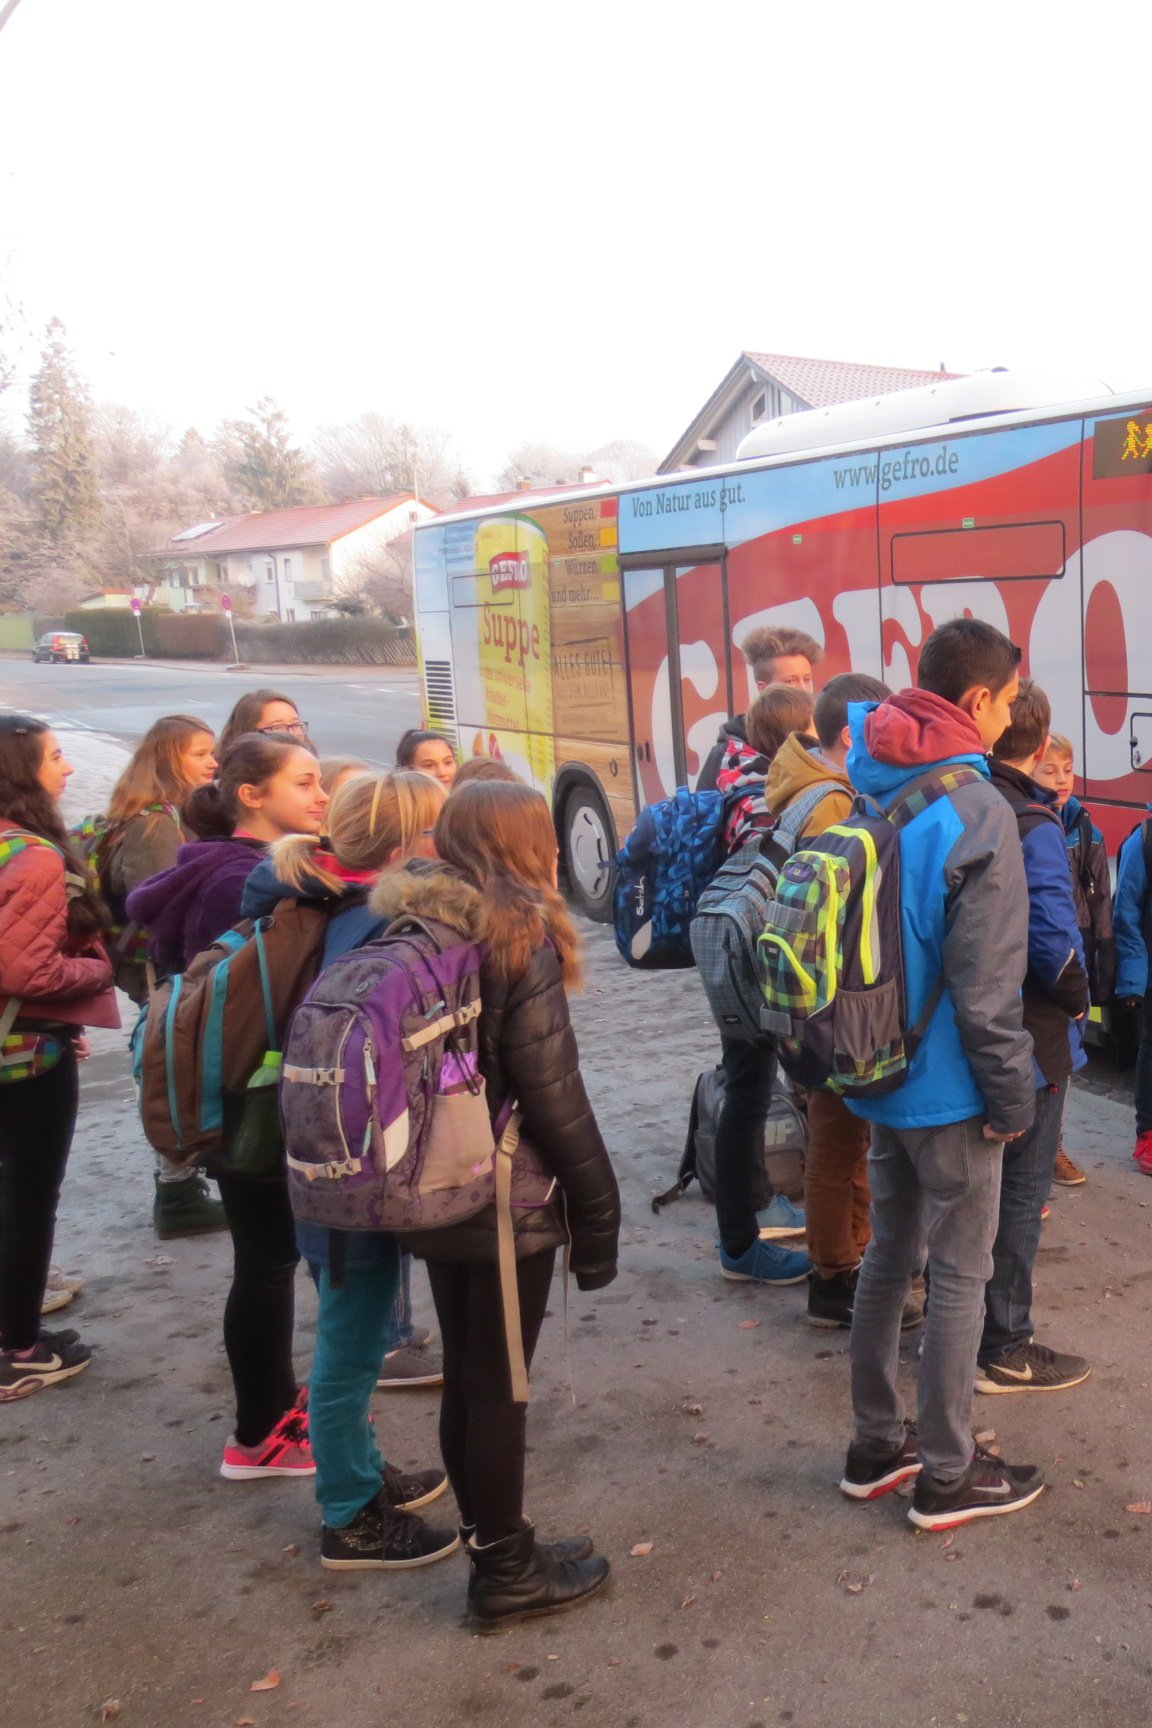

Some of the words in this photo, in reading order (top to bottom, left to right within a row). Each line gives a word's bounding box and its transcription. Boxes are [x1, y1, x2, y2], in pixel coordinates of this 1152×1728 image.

[632, 498, 653, 518] Von
[656, 493, 691, 515] Natur
[695, 490, 716, 509] aus
[719, 482, 745, 512] gut.
[563, 506, 596, 527] Suppen,
[491, 560, 528, 586] GEFRO
[483, 601, 540, 667] Suppe
[554, 653, 582, 680] ALLES
[584, 648, 609, 676] GUTE
